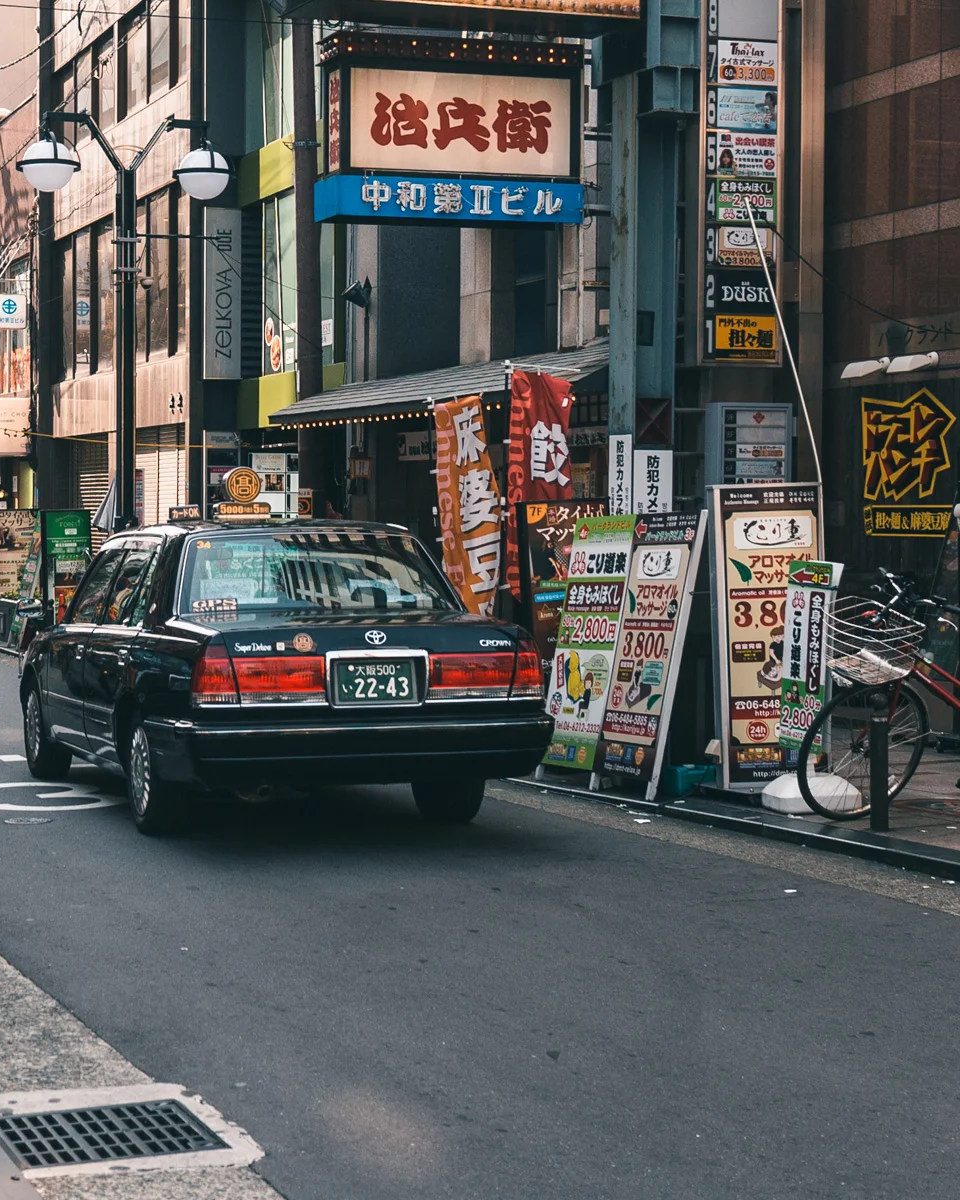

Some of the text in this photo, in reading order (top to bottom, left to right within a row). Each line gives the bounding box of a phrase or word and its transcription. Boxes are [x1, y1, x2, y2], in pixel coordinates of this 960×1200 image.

[708, 44, 717, 78] 7
[720, 57, 775, 67] タイ古式マッサージ
[708, 90, 716, 123] 6
[371, 91, 552, 154] 治兵衛
[707, 136, 716, 170] 5
[706, 181, 772, 216] 4 全身もみほぐし
[217, 229, 232, 252] DUE
[706, 228, 716, 262] 3
[707, 274, 770, 308] 2 DUSK
[705, 317, 757, 353] 1 門外不出の
[728, 329, 774, 349] 担々麺
[434, 402, 456, 551] Chinese
[171, 507, 200, 519] カードOK
[529, 506, 542, 517] 7F
[580, 528, 589, 539] 4F
[591, 519, 632, 531] パークランドビル
[684, 527, 695, 541] 3F
[197, 540, 212, 549] 34
[586, 551, 627, 575] こり道楽
[753, 569, 789, 585] マッサ
[811, 573, 824, 583] 4F
[568, 585, 621, 607] 全身もみほぐし
[636, 584, 679, 599] アロマオイル
[192, 599, 237, 609] GPS
[637, 600, 667, 617] マッサージ
[572, 616, 616, 644] 2,800円
[234, 641, 252, 654] Super
[479, 639, 511, 647] CROWN
[623, 631, 669, 659] 3,800円
[808, 596, 824, 692] 全身もみほぐし
[355, 664, 396, 677] 大阪500
[342, 676, 410, 699] い 22-43
[804, 694, 823, 711] 60分
[750, 726, 766, 734] 24h
